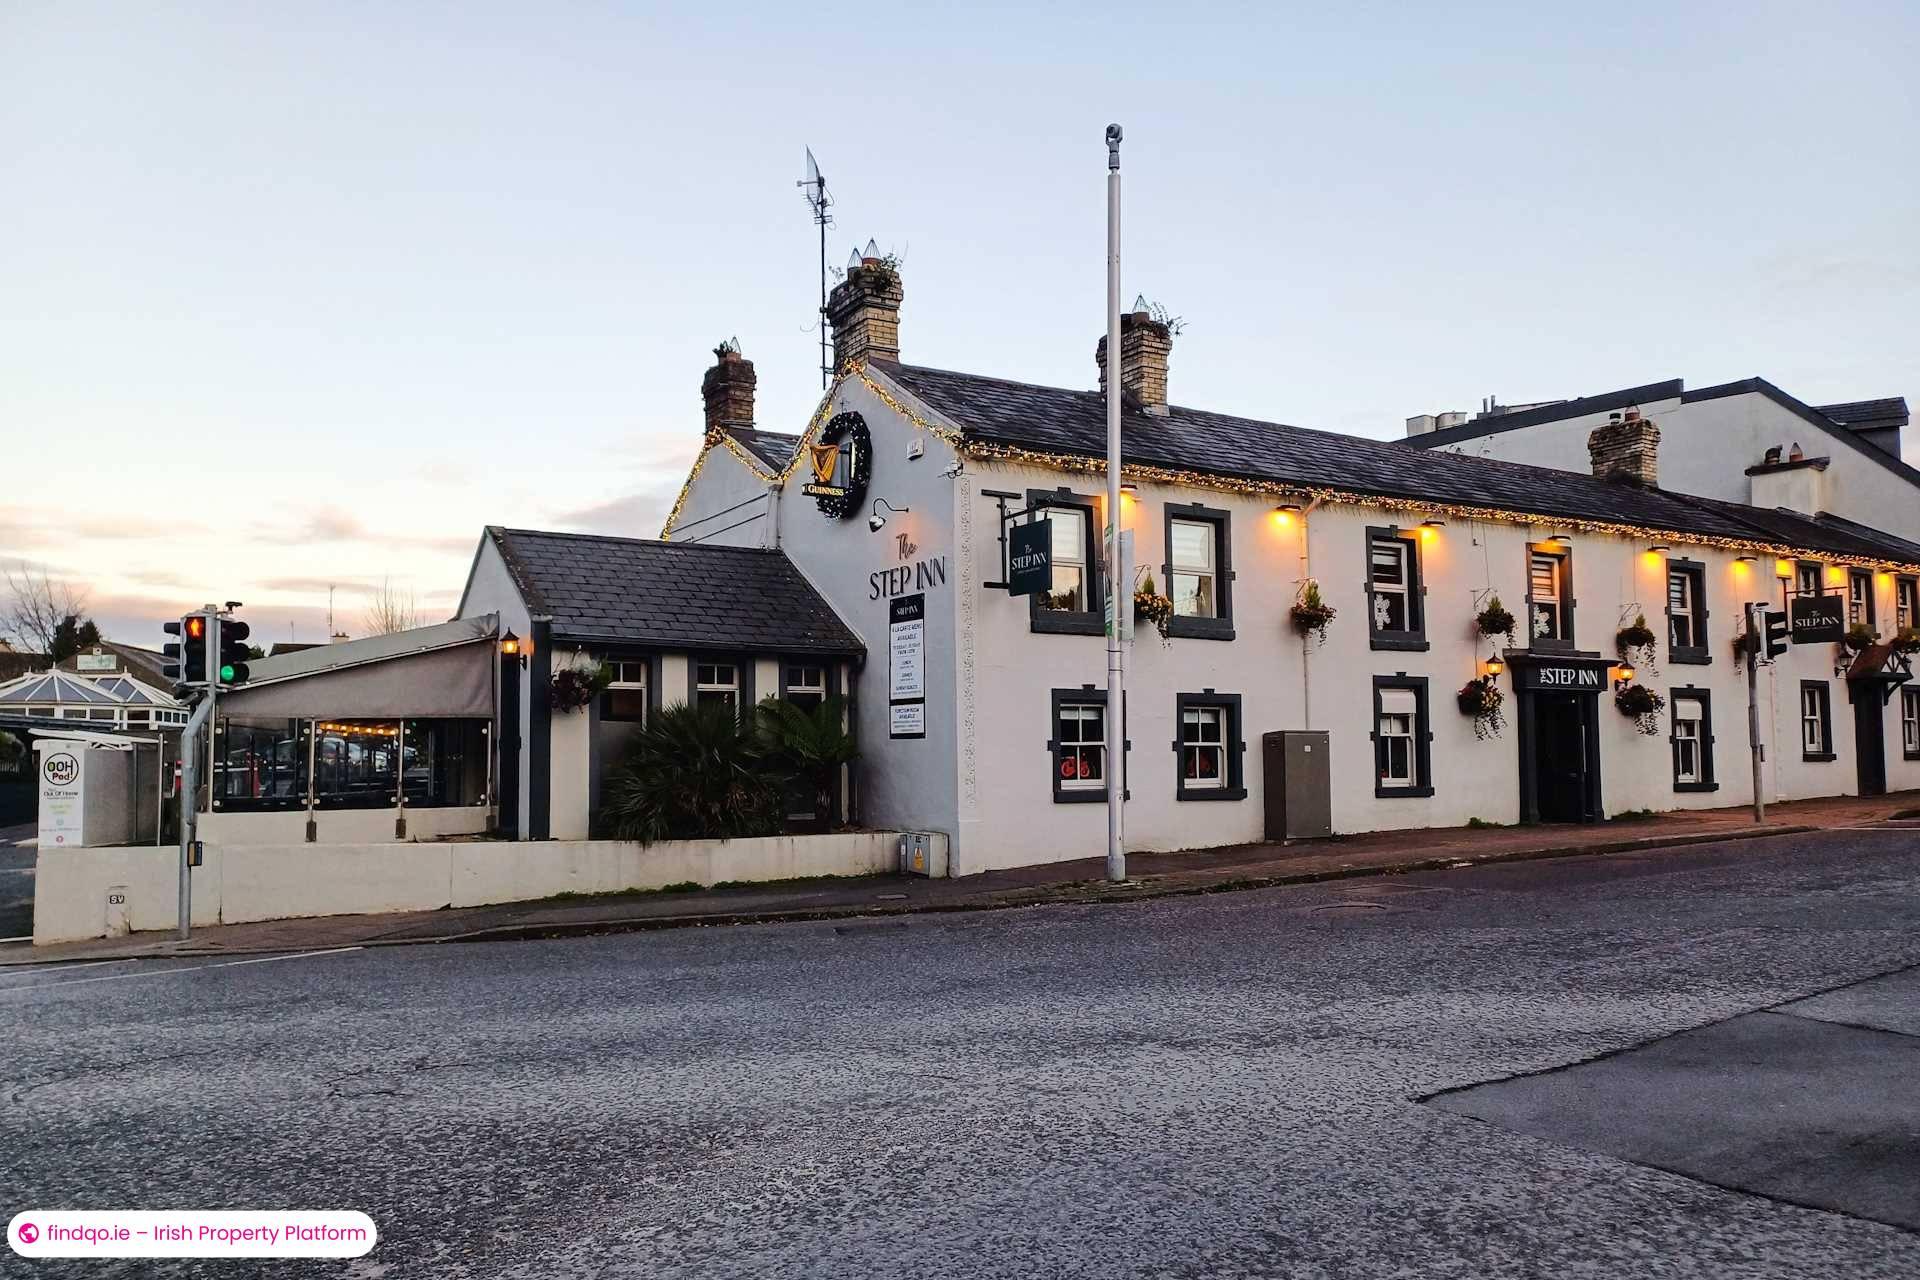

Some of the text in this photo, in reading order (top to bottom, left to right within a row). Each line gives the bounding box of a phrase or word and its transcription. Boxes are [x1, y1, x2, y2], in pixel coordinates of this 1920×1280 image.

[808, 485, 844, 496] GUINNESS
[896, 533, 918, 560] The
[1011, 551, 1047, 570] STEP INN
[869, 556, 945, 600] STEP INN
[1795, 616, 1840, 627] STEP INN
[1546, 668, 1576, 684] STEP
[1578, 669, 1598, 685] INN
[47, 760, 73, 775] OOH
[110, 895, 124, 904] SV
